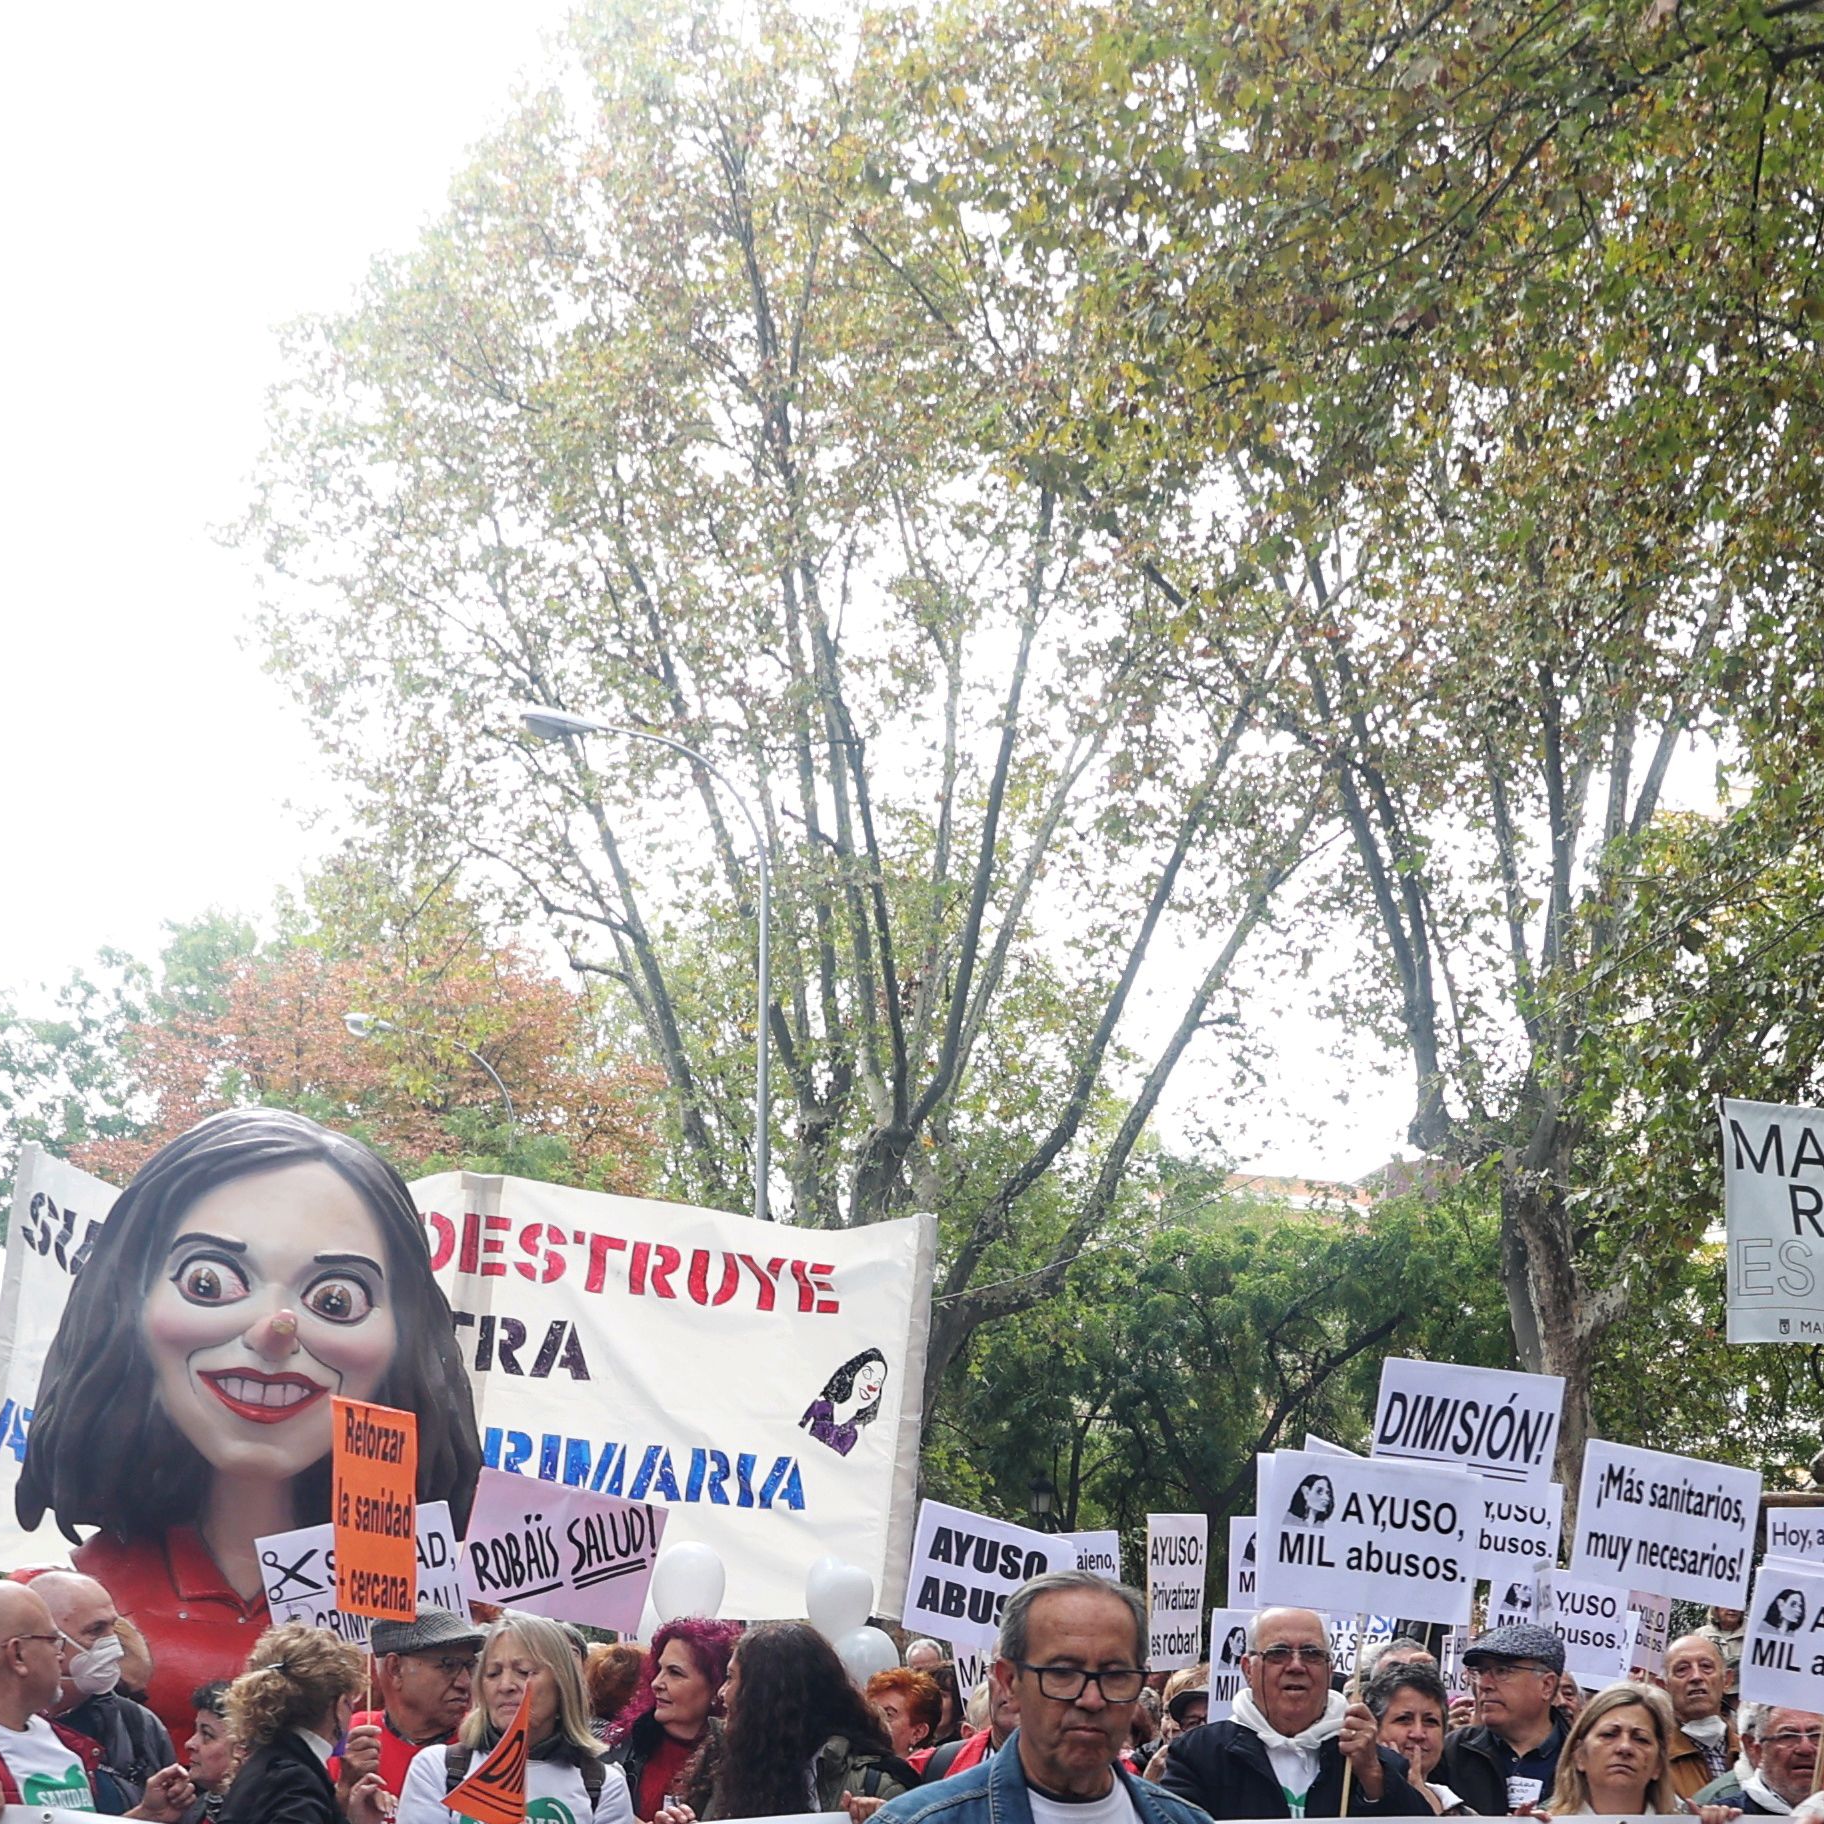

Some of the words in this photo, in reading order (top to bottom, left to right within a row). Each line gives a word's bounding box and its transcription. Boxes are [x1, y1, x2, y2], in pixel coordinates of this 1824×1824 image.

[1736, 1238, 1816, 1298] ES
[345, 1407, 406, 1465] Reforzar
[1377, 1392, 1555, 1465] DIMISIÓN!
[337, 1477, 349, 1527] la
[354, 1487, 411, 1540] sanidad
[1596, 1463, 1646, 1509] ¡Más
[1649, 1478, 1746, 1532] sanitarios,
[566, 1504, 657, 1576] SALUD!
[1150, 1535, 1203, 1567] AYUSO:
[1278, 1530, 1336, 1568] MIL
[1346, 1540, 1466, 1583] abusos.
[1586, 1530, 1633, 1572] muy
[1636, 1543, 1745, 1583] necesarios!
[1772, 1522, 1812, 1553] Hoy,
[351, 1568, 412, 1612] cercana.
[1151, 1637, 1161, 1657] es
[1162, 1625, 1199, 1656] robar!
[1751, 1638, 1801, 1672] MIL
